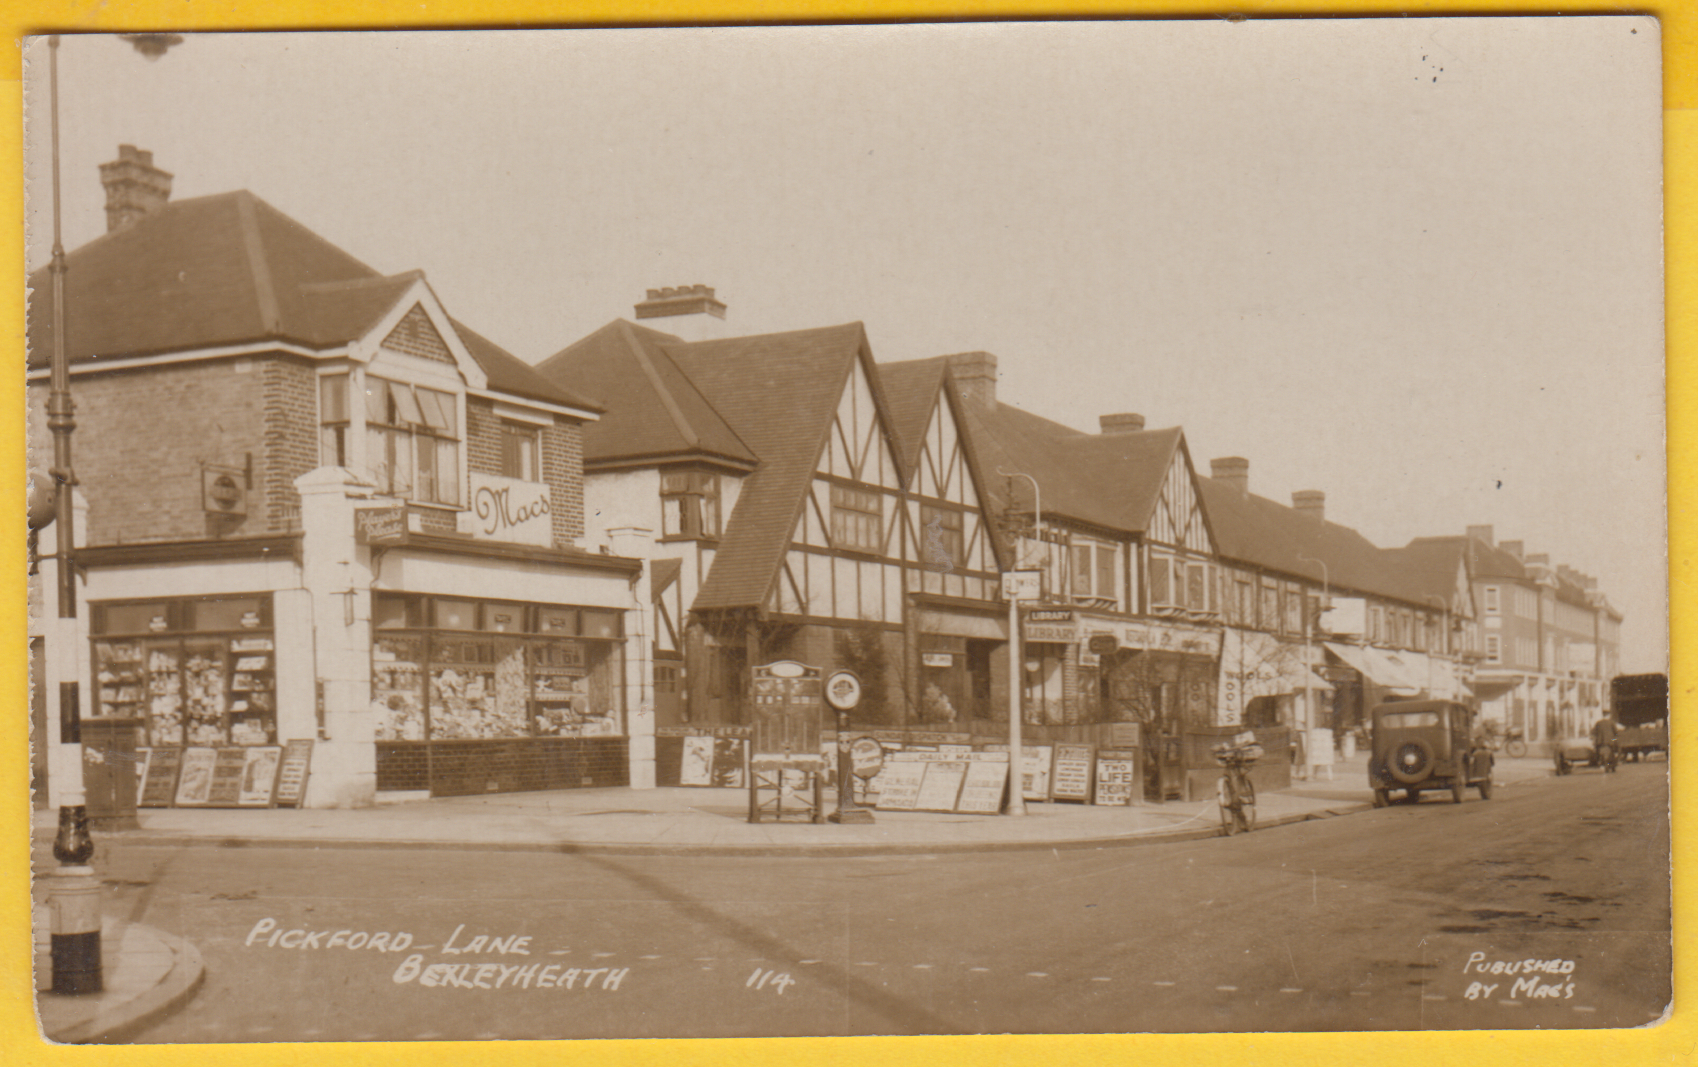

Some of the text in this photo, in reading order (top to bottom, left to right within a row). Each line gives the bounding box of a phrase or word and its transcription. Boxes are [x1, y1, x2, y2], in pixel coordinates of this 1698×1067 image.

[476, 486, 550, 535] Macs
[1031, 611, 1071, 620] LIBRARY
[1027, 627, 1075, 640] LIBRARY
[695, 727, 720, 736] THE
[1099, 772, 1131, 783] LIFE
